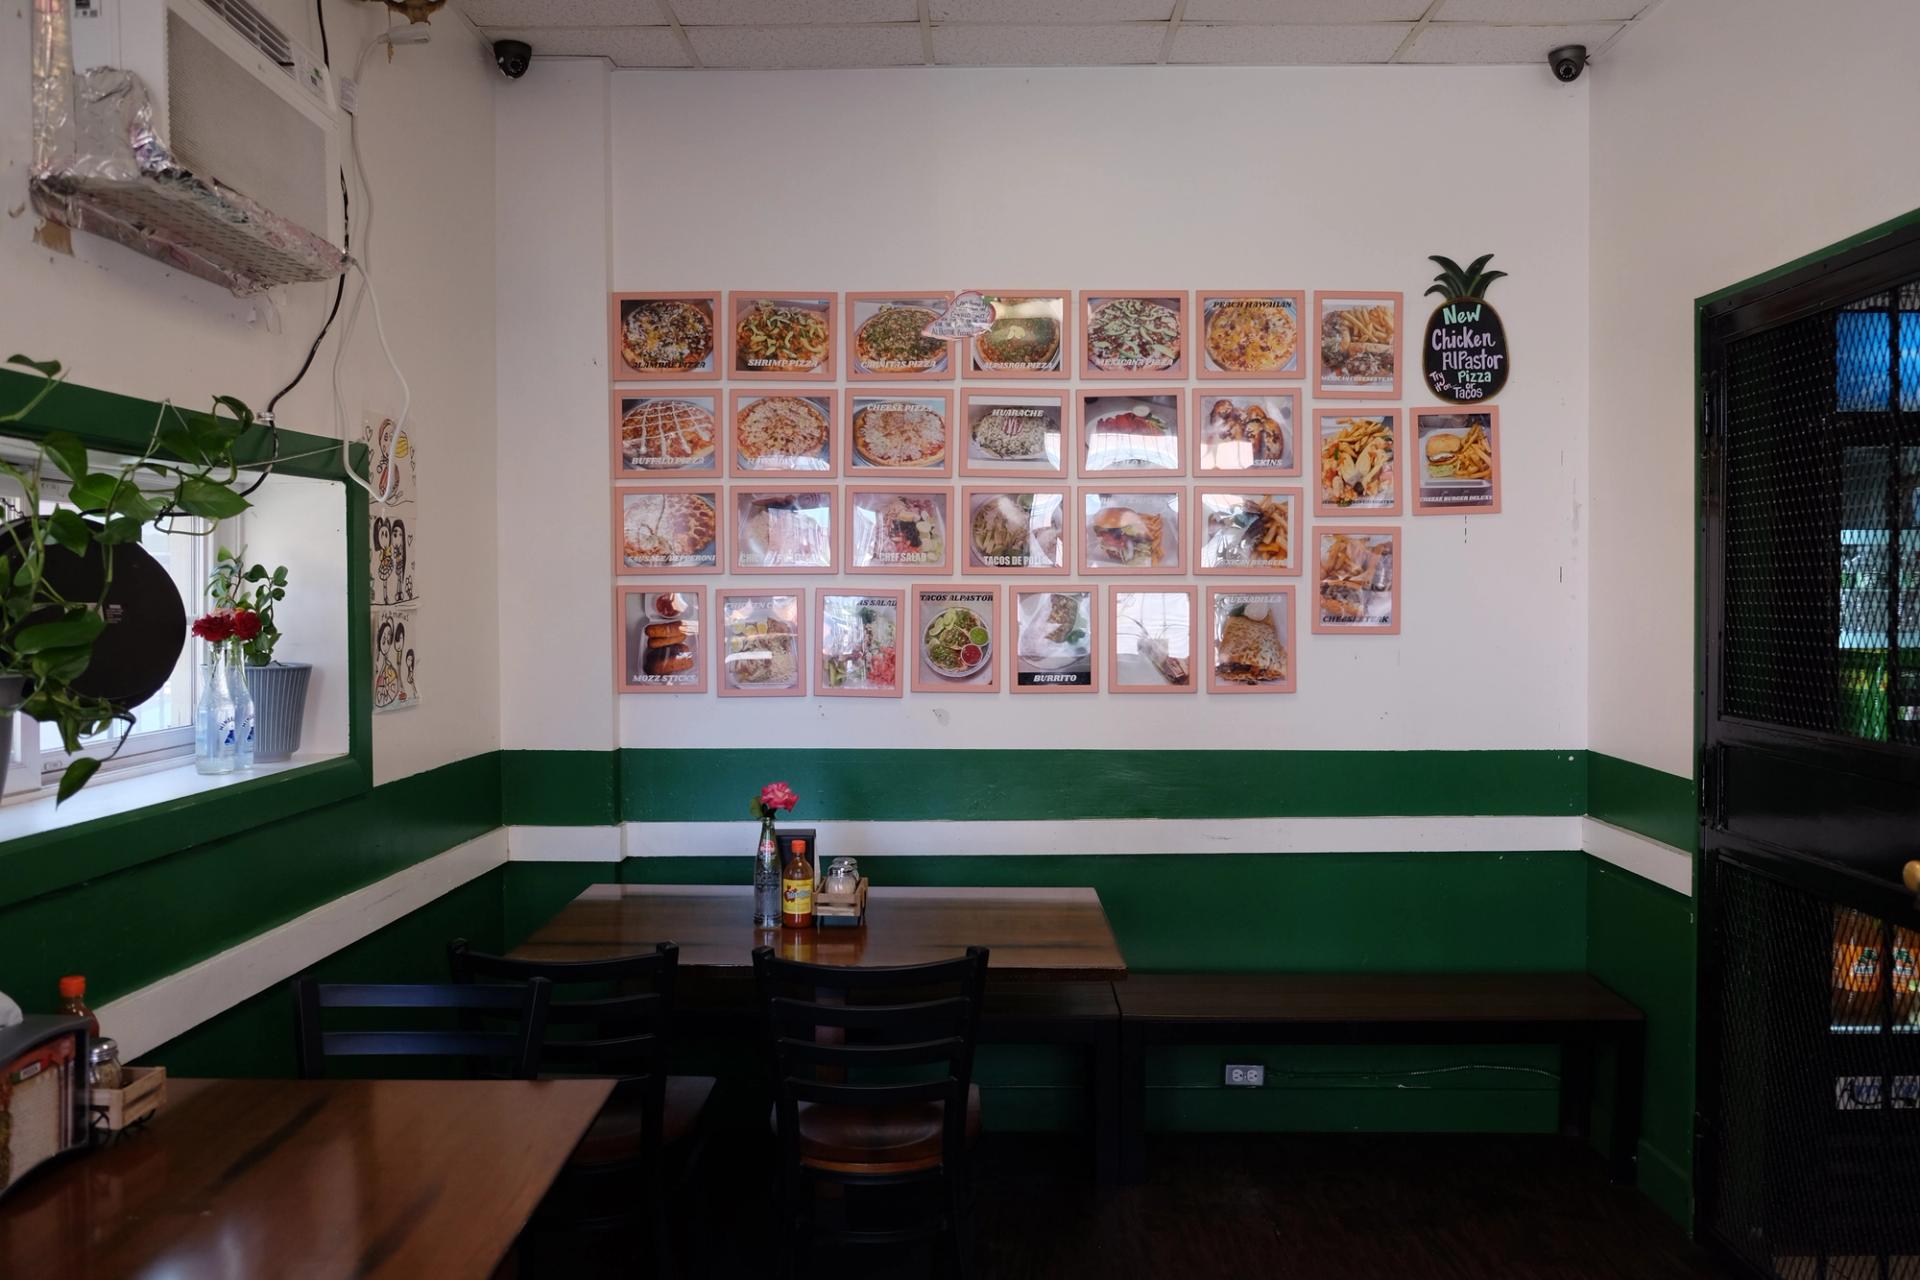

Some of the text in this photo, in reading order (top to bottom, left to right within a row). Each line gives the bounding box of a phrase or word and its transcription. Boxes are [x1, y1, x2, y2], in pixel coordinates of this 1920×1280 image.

[1443, 304, 1482, 325] New
[1432, 326, 1497, 351] Chicken
[747, 359, 818, 367] SHRIMP PIZZA
[1429, 371, 1446, 386] Try
[1457, 370, 1492, 383] Pizza
[1453, 386, 1483, 400] Tacos
[992, 409, 1044, 417] HUARACHE
[879, 552, 928, 562] CHEF SALAD
[983, 556, 1010, 566] TACOS
[1011, 556, 1022, 566] DE
[632, 674, 697, 683] MOZZ STICKS
[1033, 674, 1078, 682] BURRITO
